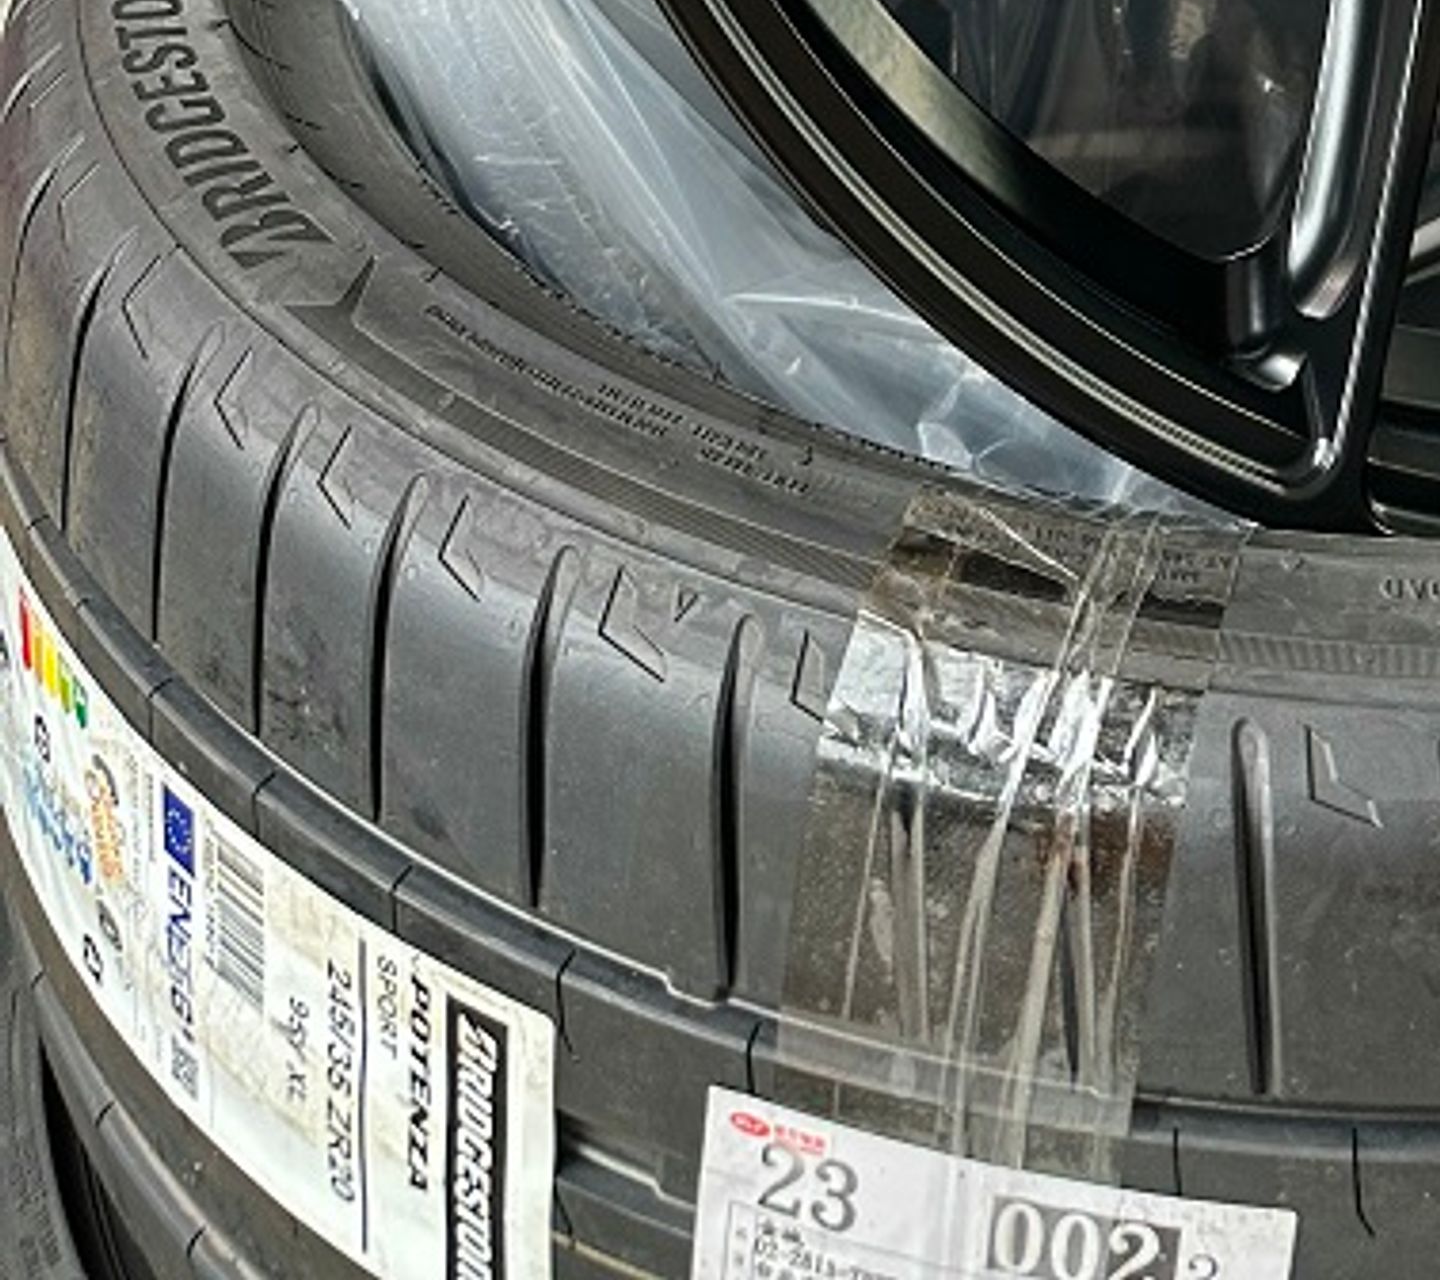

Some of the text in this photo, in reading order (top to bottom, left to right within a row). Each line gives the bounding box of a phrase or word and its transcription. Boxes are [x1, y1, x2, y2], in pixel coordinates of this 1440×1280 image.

[377, 955, 397, 1060] SPORT
[408, 974, 432, 1192] POTENZA
[455, 1013, 498, 1280] BRIDGESTON
[757, 1140, 858, 1232] 23
